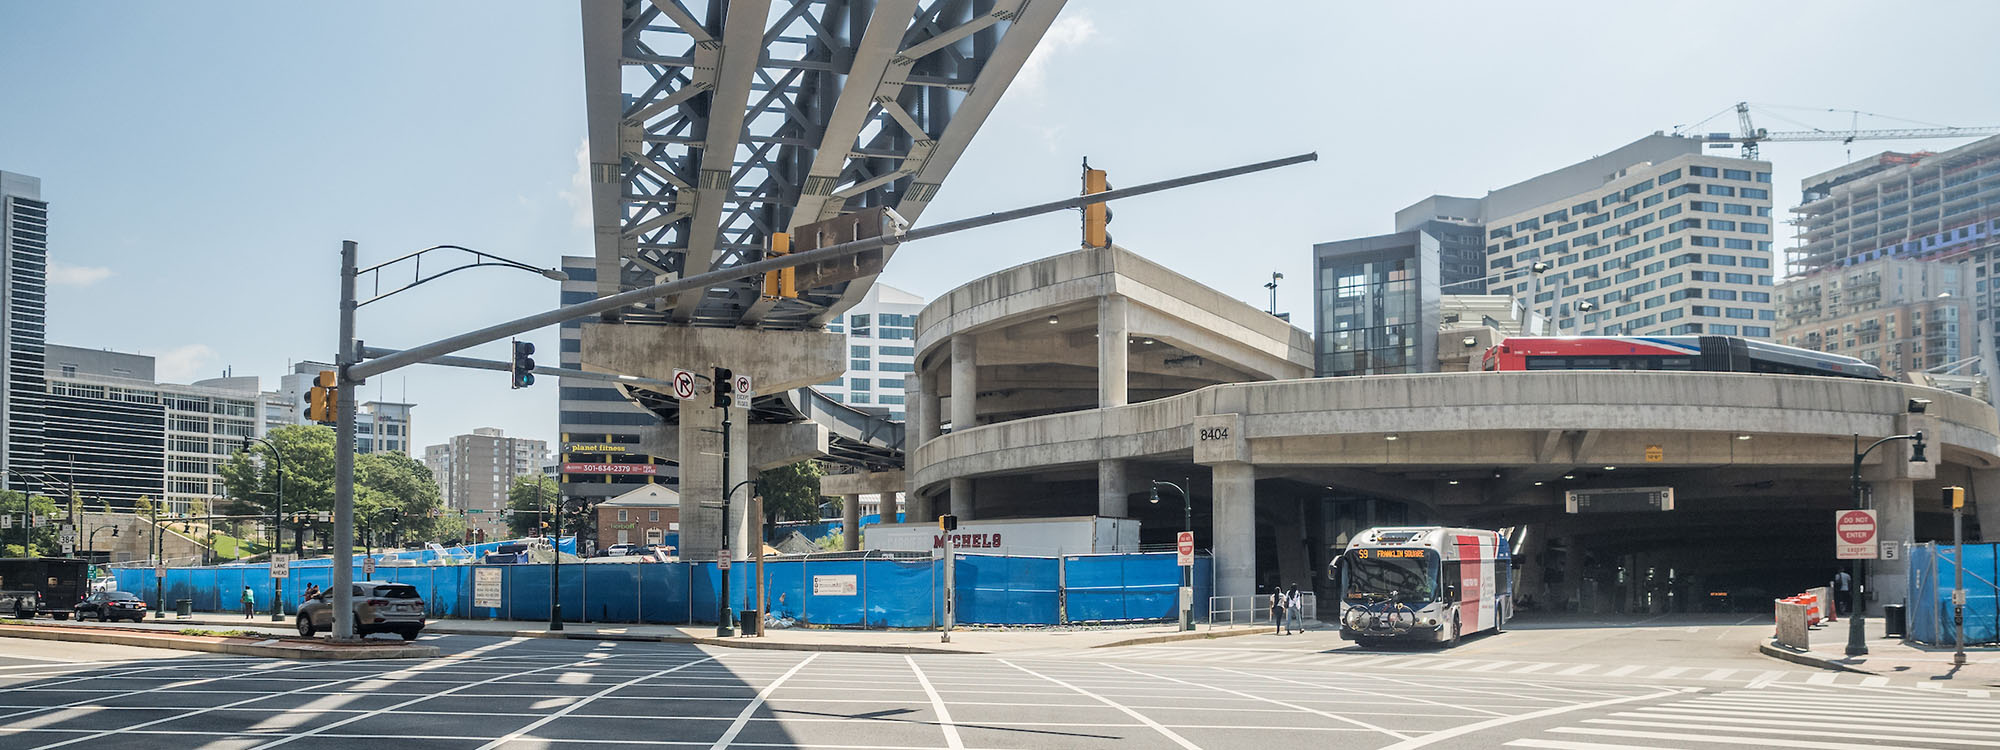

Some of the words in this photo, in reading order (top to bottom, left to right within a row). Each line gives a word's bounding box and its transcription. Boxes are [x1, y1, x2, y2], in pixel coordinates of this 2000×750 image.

[1200, 428, 1228, 441] 8404
[572, 444, 597, 452] planet
[599, 444, 626, 452] fitness
[583, 464, 631, 472] 301-634-2379
[60, 535, 75, 544] 384
[1846, 531, 1867, 539] ENTER
[1358, 549, 1369, 559] S9
[1376, 550, 1404, 558] FRANKLIN
[1404, 550, 1425, 558] SQUARE
[1886, 550, 1894, 559] 5
